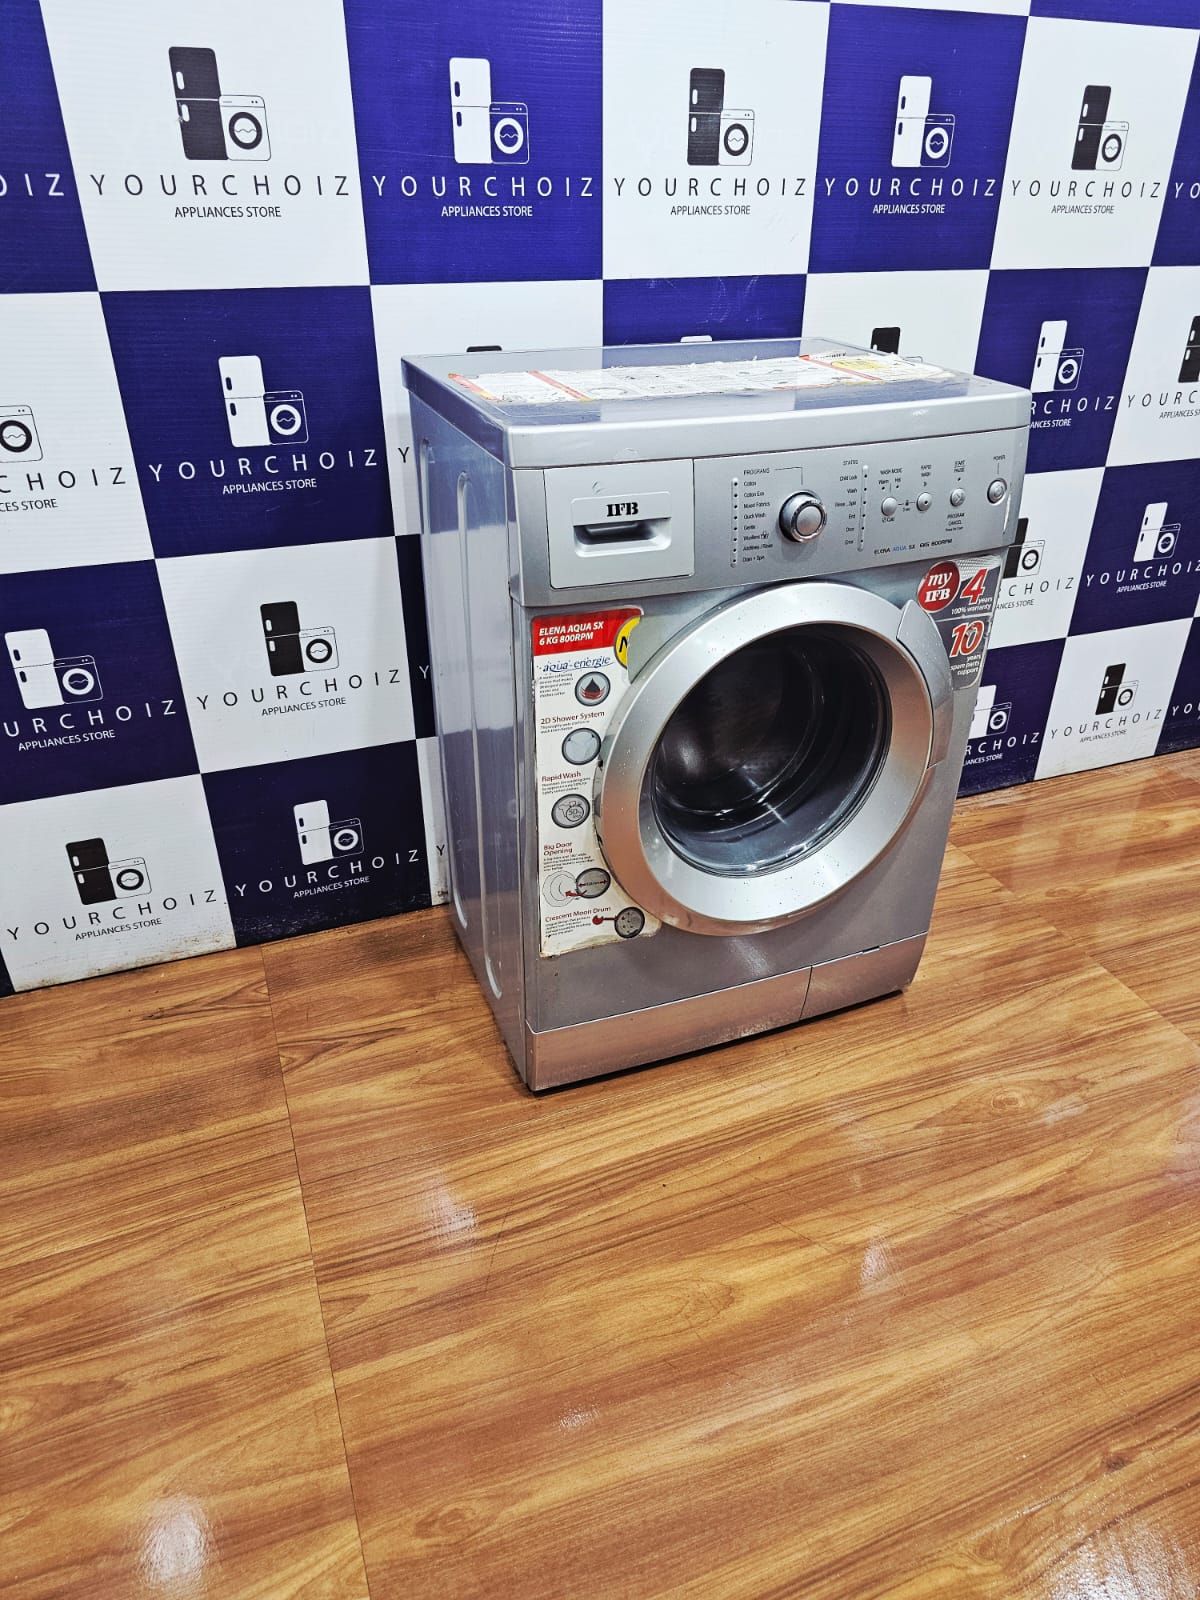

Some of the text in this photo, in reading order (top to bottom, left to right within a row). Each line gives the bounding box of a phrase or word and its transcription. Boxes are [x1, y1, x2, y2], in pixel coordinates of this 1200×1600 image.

[90, 174, 349, 196] YOURCHOIZ
[372, 175, 593, 197] YOURCHOIZ
[614, 177, 806, 197] YOURCHOIZ
[824, 178, 996, 197] YOURCHOIZ
[1012, 180, 1161, 198] YOURCHOIZ
[174, 206, 281, 218] APPLIANCES STORE
[441, 205, 534, 217] APPLIANCES STORE
[670, 205, 751, 216] APPLIANCES STORE
[872, 203, 946, 214] APPLIANCES STORE
[1051, 204, 1115, 215] APPLIANCES STORE
[1052, 418, 1072, 428] STORE
[149, 449, 378, 482] YOURCHOIZ
[223, 478, 317, 495] APPLIANCES STORE
[21, 498, 59, 510] STORE
[606, 502, 639, 517] IFB
[928, 572, 953, 589] my
[960, 567, 989, 605] 4
[1116, 582, 1151, 594] APPLIANCES
[925, 588, 951, 603] IFB
[539, 621, 604, 637] ELENA AQUA SX
[539, 632, 594, 646] 6 KG 800RPM
[949, 620, 985, 657] 10
[196, 669, 401, 710] YOURCHOIZ
[261, 697, 347, 716] APPLIANCES STORE
[552, 714, 579, 723] Shower
[580, 711, 605, 720] System
[18, 729, 116, 751] APPLIANCES STORE
[1080, 732, 1110, 743] APPLIANCES
[541, 770, 582, 782] Rapid Wash
[235, 849, 420, 897] YOURCHOIZ
[293, 875, 371, 899] APPLIANCES STORE
[7, 889, 217, 941] YOURCHOIZ
[75, 917, 163, 941] APPLIANCES STORE
